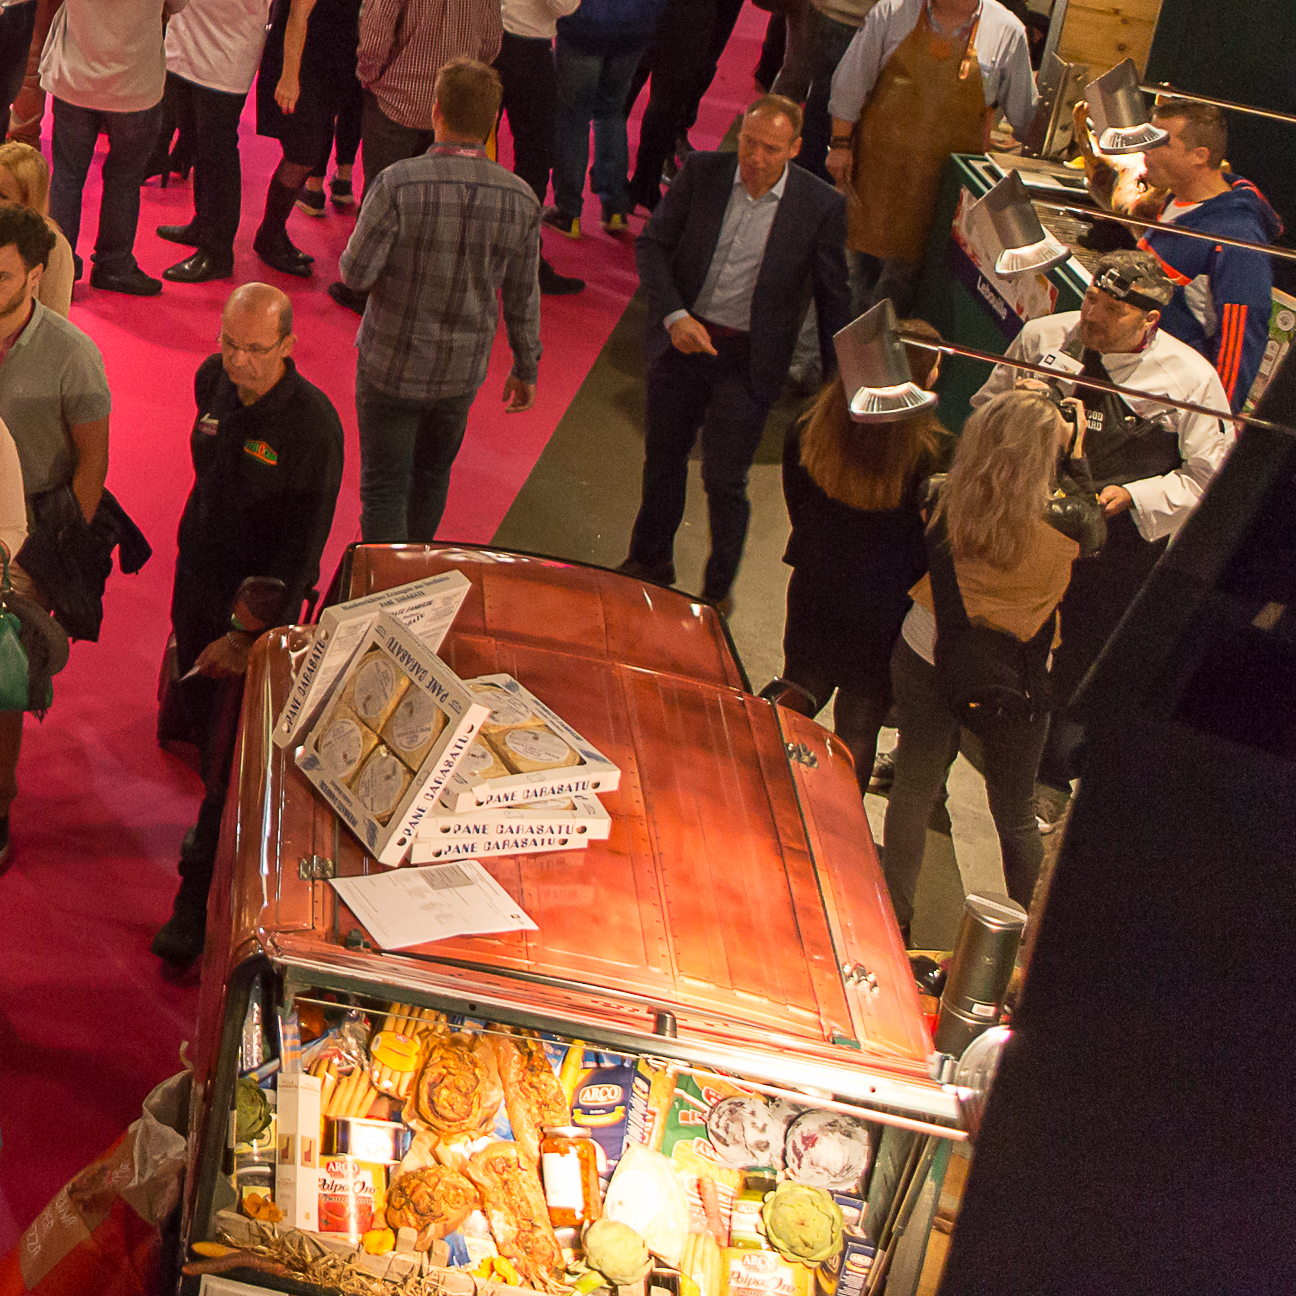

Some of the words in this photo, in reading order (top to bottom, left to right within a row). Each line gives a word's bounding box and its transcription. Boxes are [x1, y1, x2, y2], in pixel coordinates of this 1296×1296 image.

[426, 676, 450, 703] PANE
[286, 697, 302, 733] PANE
[486, 790, 518, 805] PANE
[403, 805, 426, 836] PANE
[453, 824, 490, 835] PANE
[443, 841, 478, 856] PANE
[582, 1087, 619, 1102] ARCO
[327, 1161, 358, 1173] ARCO
[737, 1204, 756, 1214] ARCO
[743, 1254, 776, 1268] ARCO
